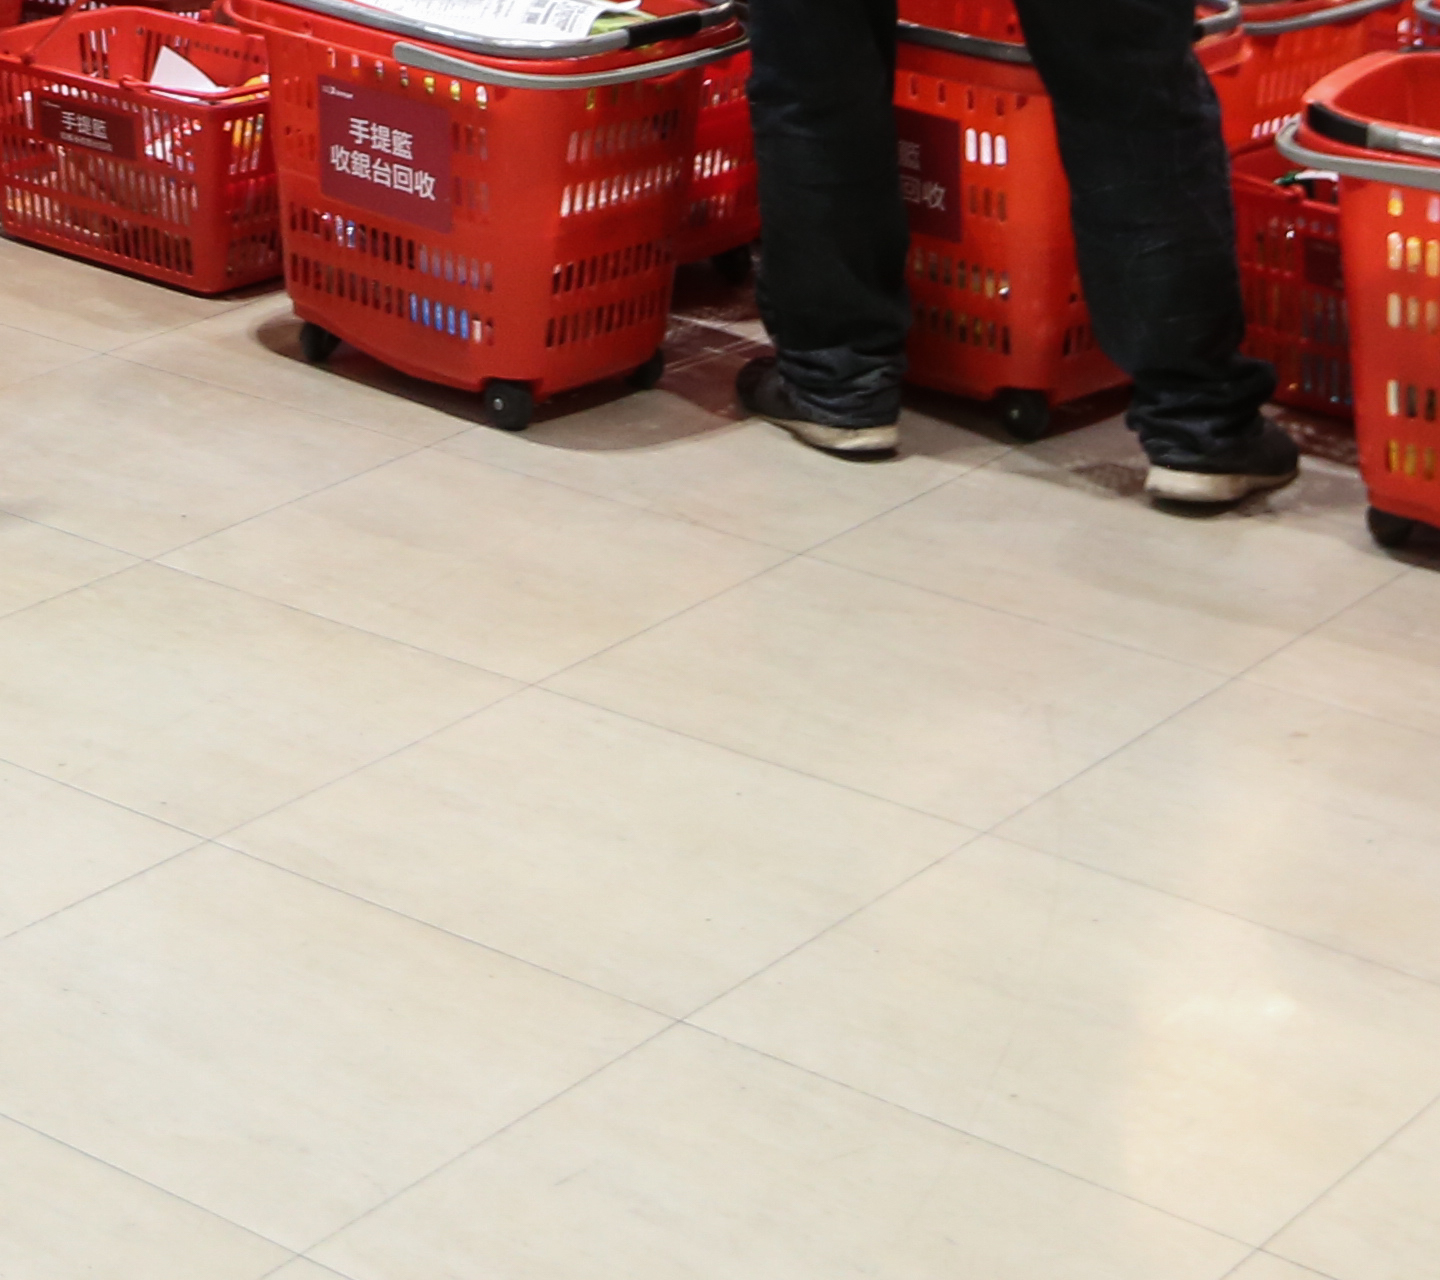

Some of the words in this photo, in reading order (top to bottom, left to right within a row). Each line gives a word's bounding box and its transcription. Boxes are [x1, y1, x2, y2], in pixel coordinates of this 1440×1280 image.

[60, 110, 109, 140] 手提籃
[348, 116, 413, 162] 手提籃
[329, 143, 437, 203] 收銀台回收
